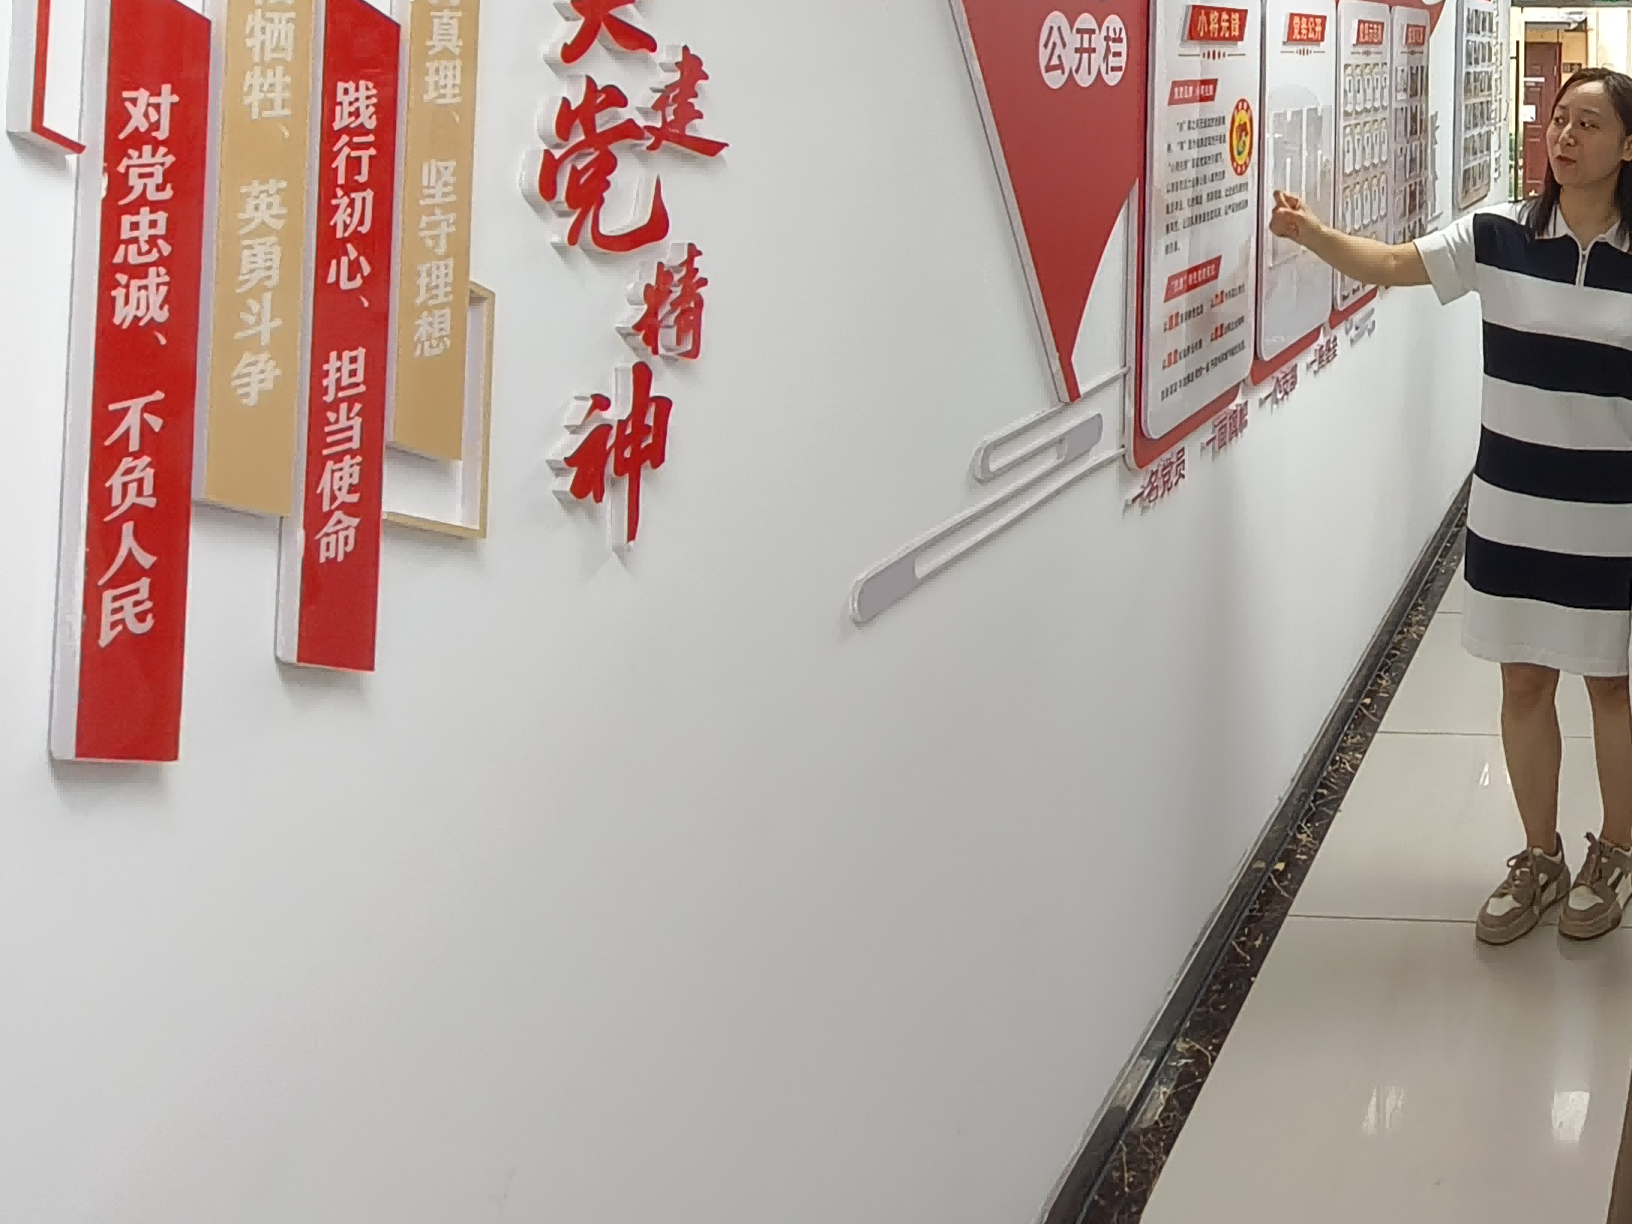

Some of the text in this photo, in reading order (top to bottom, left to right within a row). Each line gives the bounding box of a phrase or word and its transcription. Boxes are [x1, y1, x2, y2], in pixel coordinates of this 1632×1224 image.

[1042, 20, 1126, 80] 公开栏
[1197, 9, 1240, 38] 小将先锋
[1292, 16, 1323, 41] 党务公开
[315, 79, 378, 564] 践行初心、担当使命
[97, 87, 180, 648] 对党忠诚、不负人民
[1132, 447, 1186, 504] 一名党员
